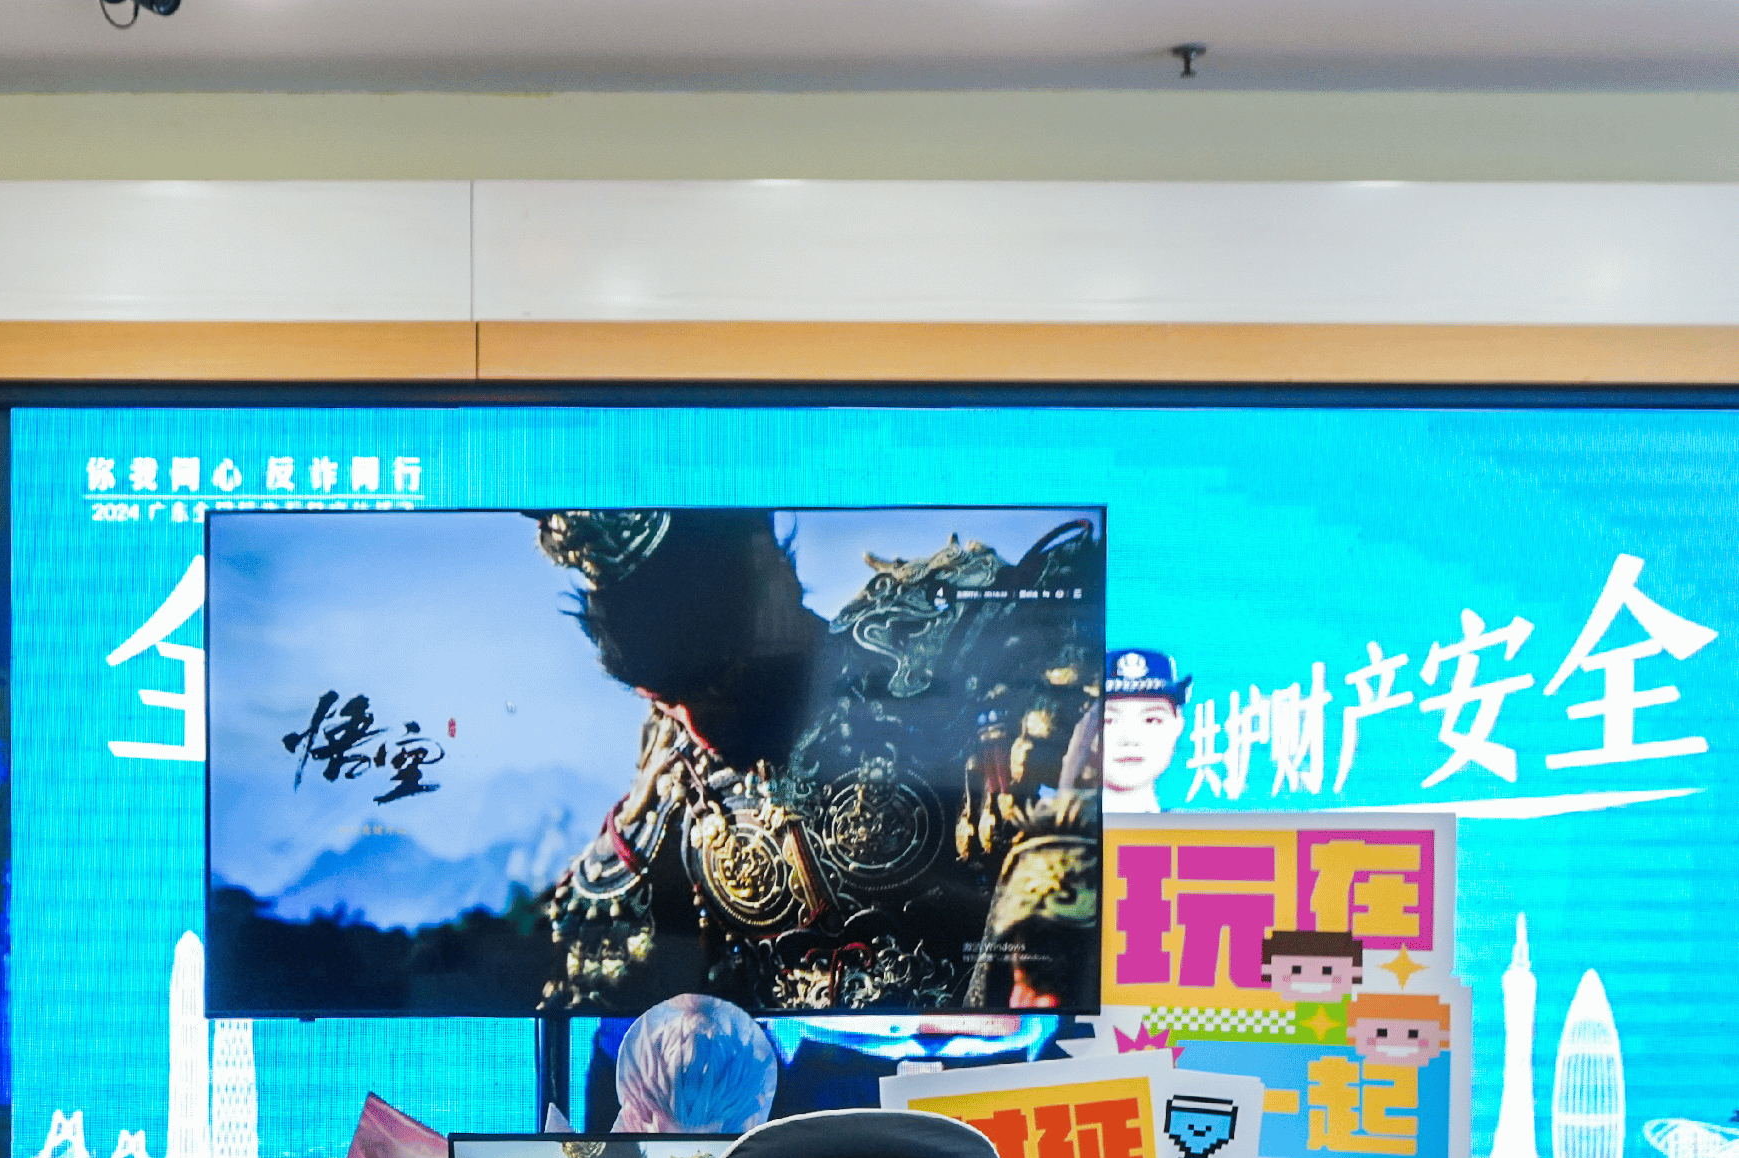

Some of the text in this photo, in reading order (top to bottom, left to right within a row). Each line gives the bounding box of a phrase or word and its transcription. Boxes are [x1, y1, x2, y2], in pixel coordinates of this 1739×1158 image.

[87, 456, 243, 492] 你我同心
[1115, 839, 1421, 989] 玩在
